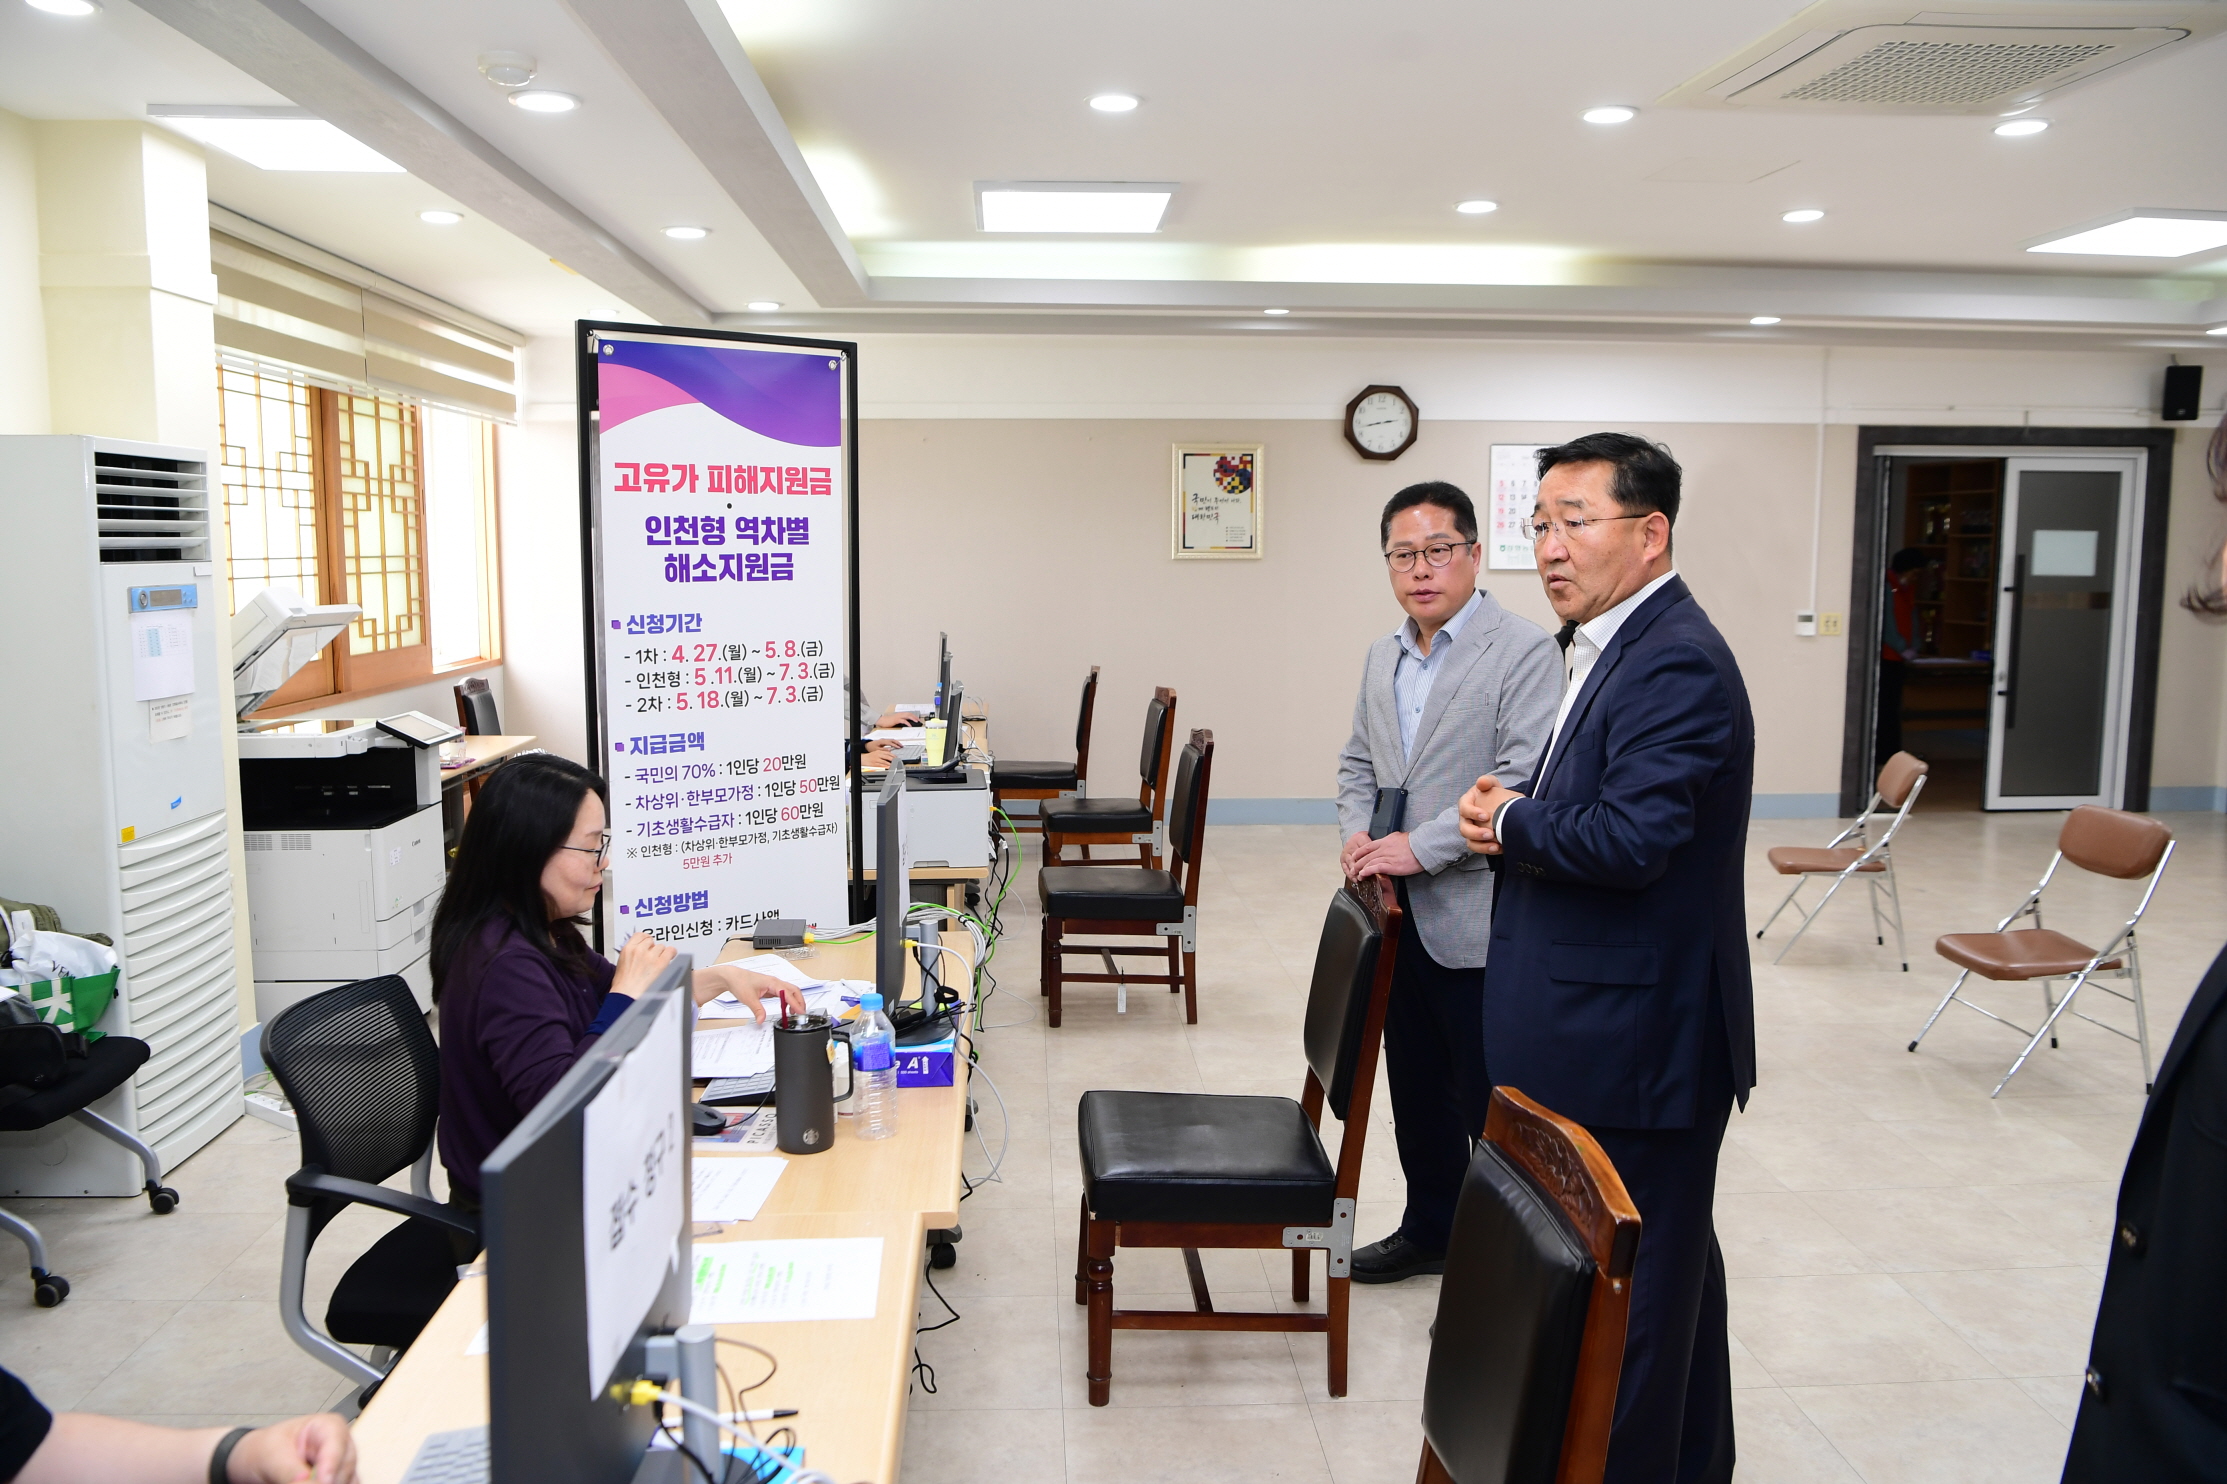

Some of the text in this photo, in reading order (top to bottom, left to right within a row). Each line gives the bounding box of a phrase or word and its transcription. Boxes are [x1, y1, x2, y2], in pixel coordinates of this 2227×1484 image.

[614, 462, 832, 496] 고유가 피해지원금
[645, 515, 810, 546] 인천형 역차별
[664, 553, 794, 583] 해소지원금
[627, 613, 703, 635] 신청기간
[636, 671, 681, 690] 인천형
[630, 731, 705, 755] 지급금액
[635, 765, 678, 785] 국민의
[681, 763, 716, 780] 70%
[726, 758, 760, 776] 1인당
[763, 753, 807, 773] 20만원
[635, 784, 754, 812] 차상위·한부모가정
[764, 780, 797, 798] 1인당
[799, 774, 841, 794] 50만원
[636, 812, 735, 838] 기초생활수급자
[745, 807, 778, 826] 1인당
[780, 802, 824, 821] 60만원
[640, 843, 672, 858] 인천형
[772, 821, 838, 842] 기초생활수급자)
[683, 852, 733, 870] 5만원 추가
[634, 890, 709, 918] 신청방법
[746, 1113, 777, 1145] PICASSO
